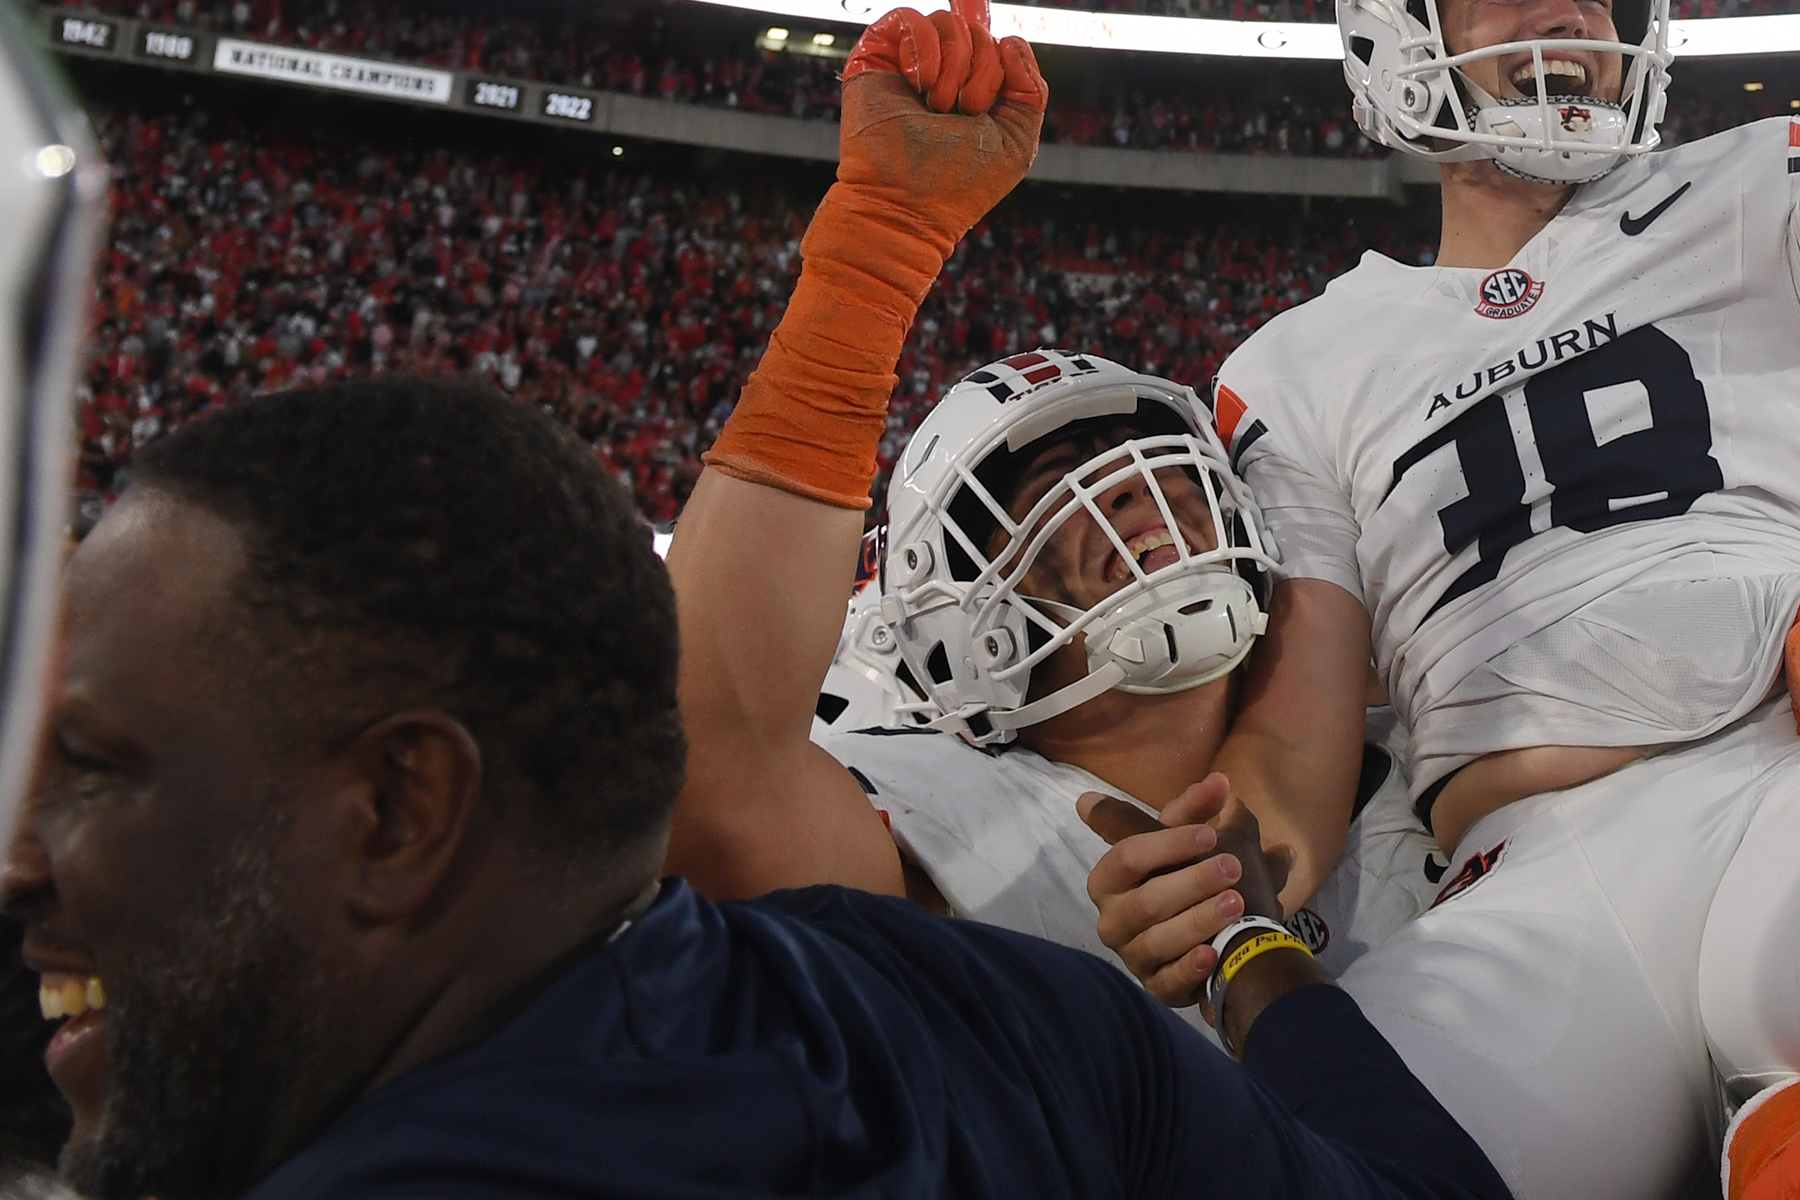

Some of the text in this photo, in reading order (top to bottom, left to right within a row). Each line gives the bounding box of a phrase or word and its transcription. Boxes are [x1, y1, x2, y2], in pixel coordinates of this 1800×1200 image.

[230, 49, 435, 93] NATIONAL CHAMPIONS
[474, 81, 519, 109] 2021
[546, 92, 592, 121] 2022
[1484, 271, 1528, 304] SEC
[1485, 291, 1538, 317] GRADUATE
[1425, 312, 1619, 422] AUBURN
[1380, 323, 1724, 628] 18
[1255, 932, 1278, 947] Psi
